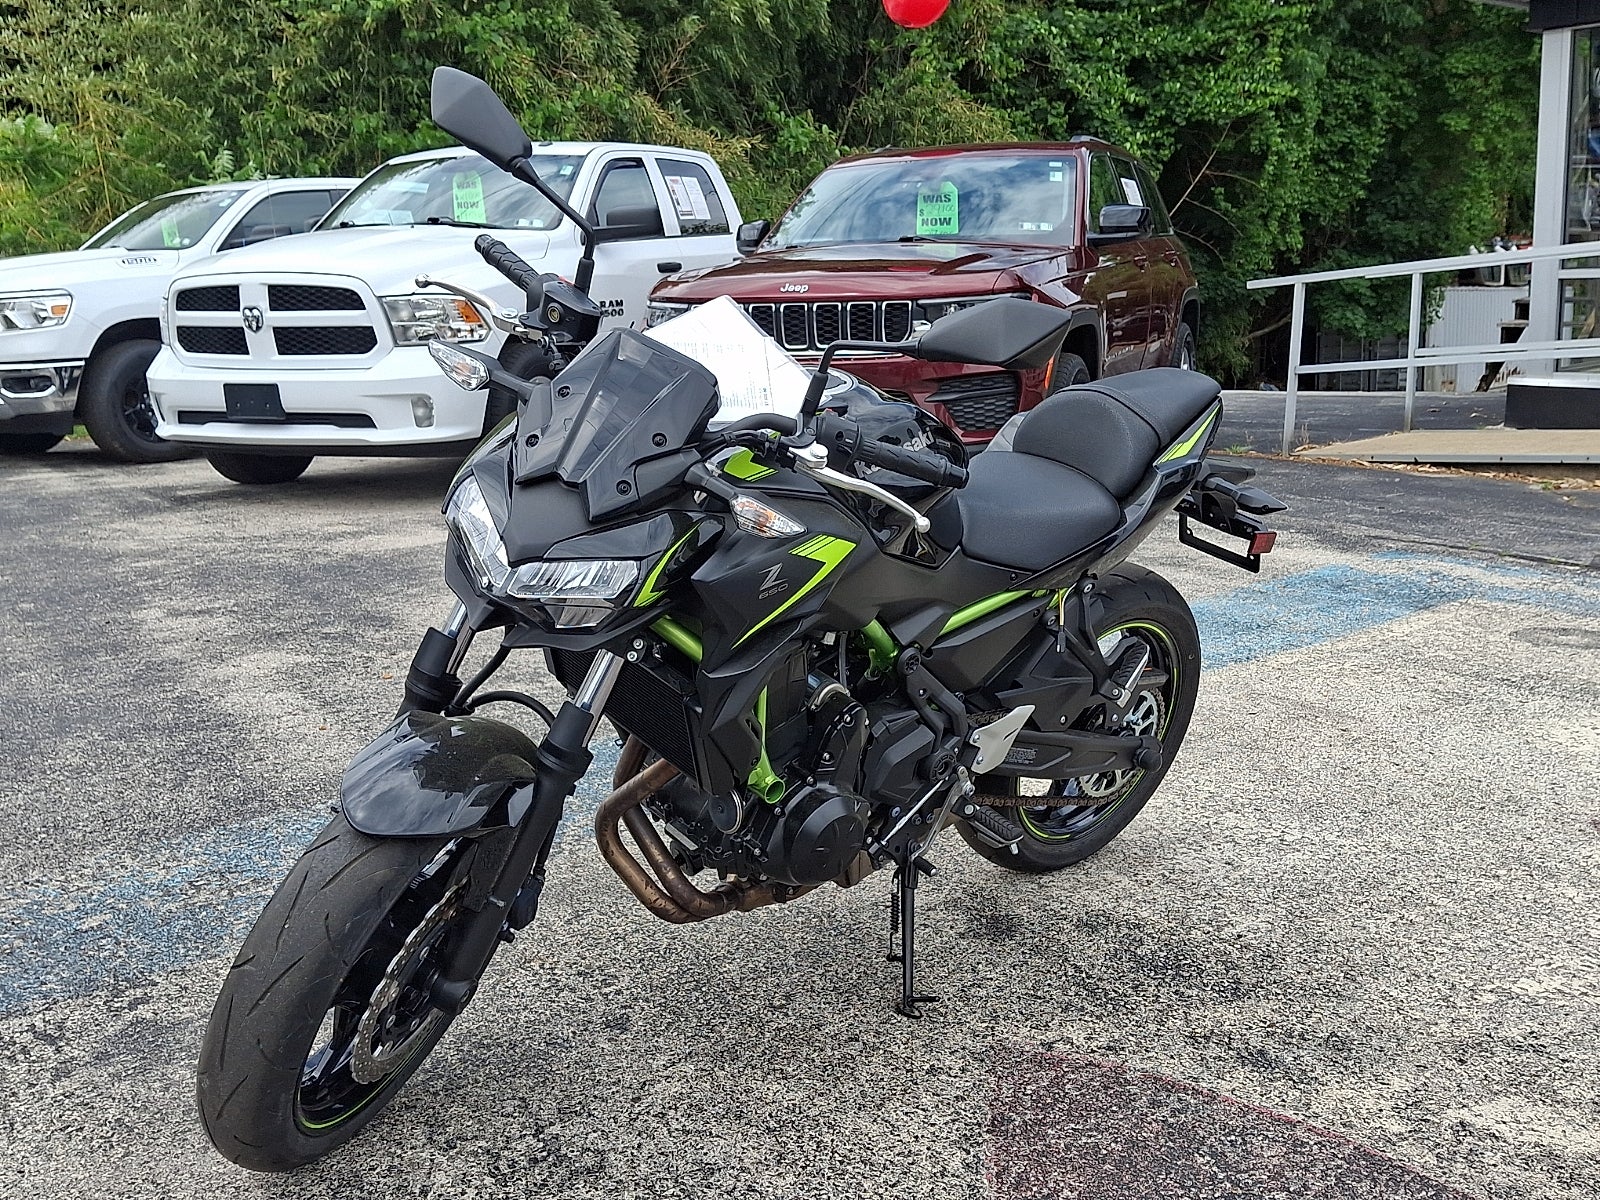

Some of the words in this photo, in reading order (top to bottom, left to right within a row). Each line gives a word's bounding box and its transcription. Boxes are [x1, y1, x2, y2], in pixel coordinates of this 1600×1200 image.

[922, 194, 952, 203] WAS
[456, 201, 480, 209] NOW
[921, 217, 952, 227] NOW
[780, 283, 809, 294] Jeep
[599, 299, 624, 308] RAM
[600, 308, 624, 318] 500
[758, 562, 788, 591] Z
[758, 583, 789, 600] 650
